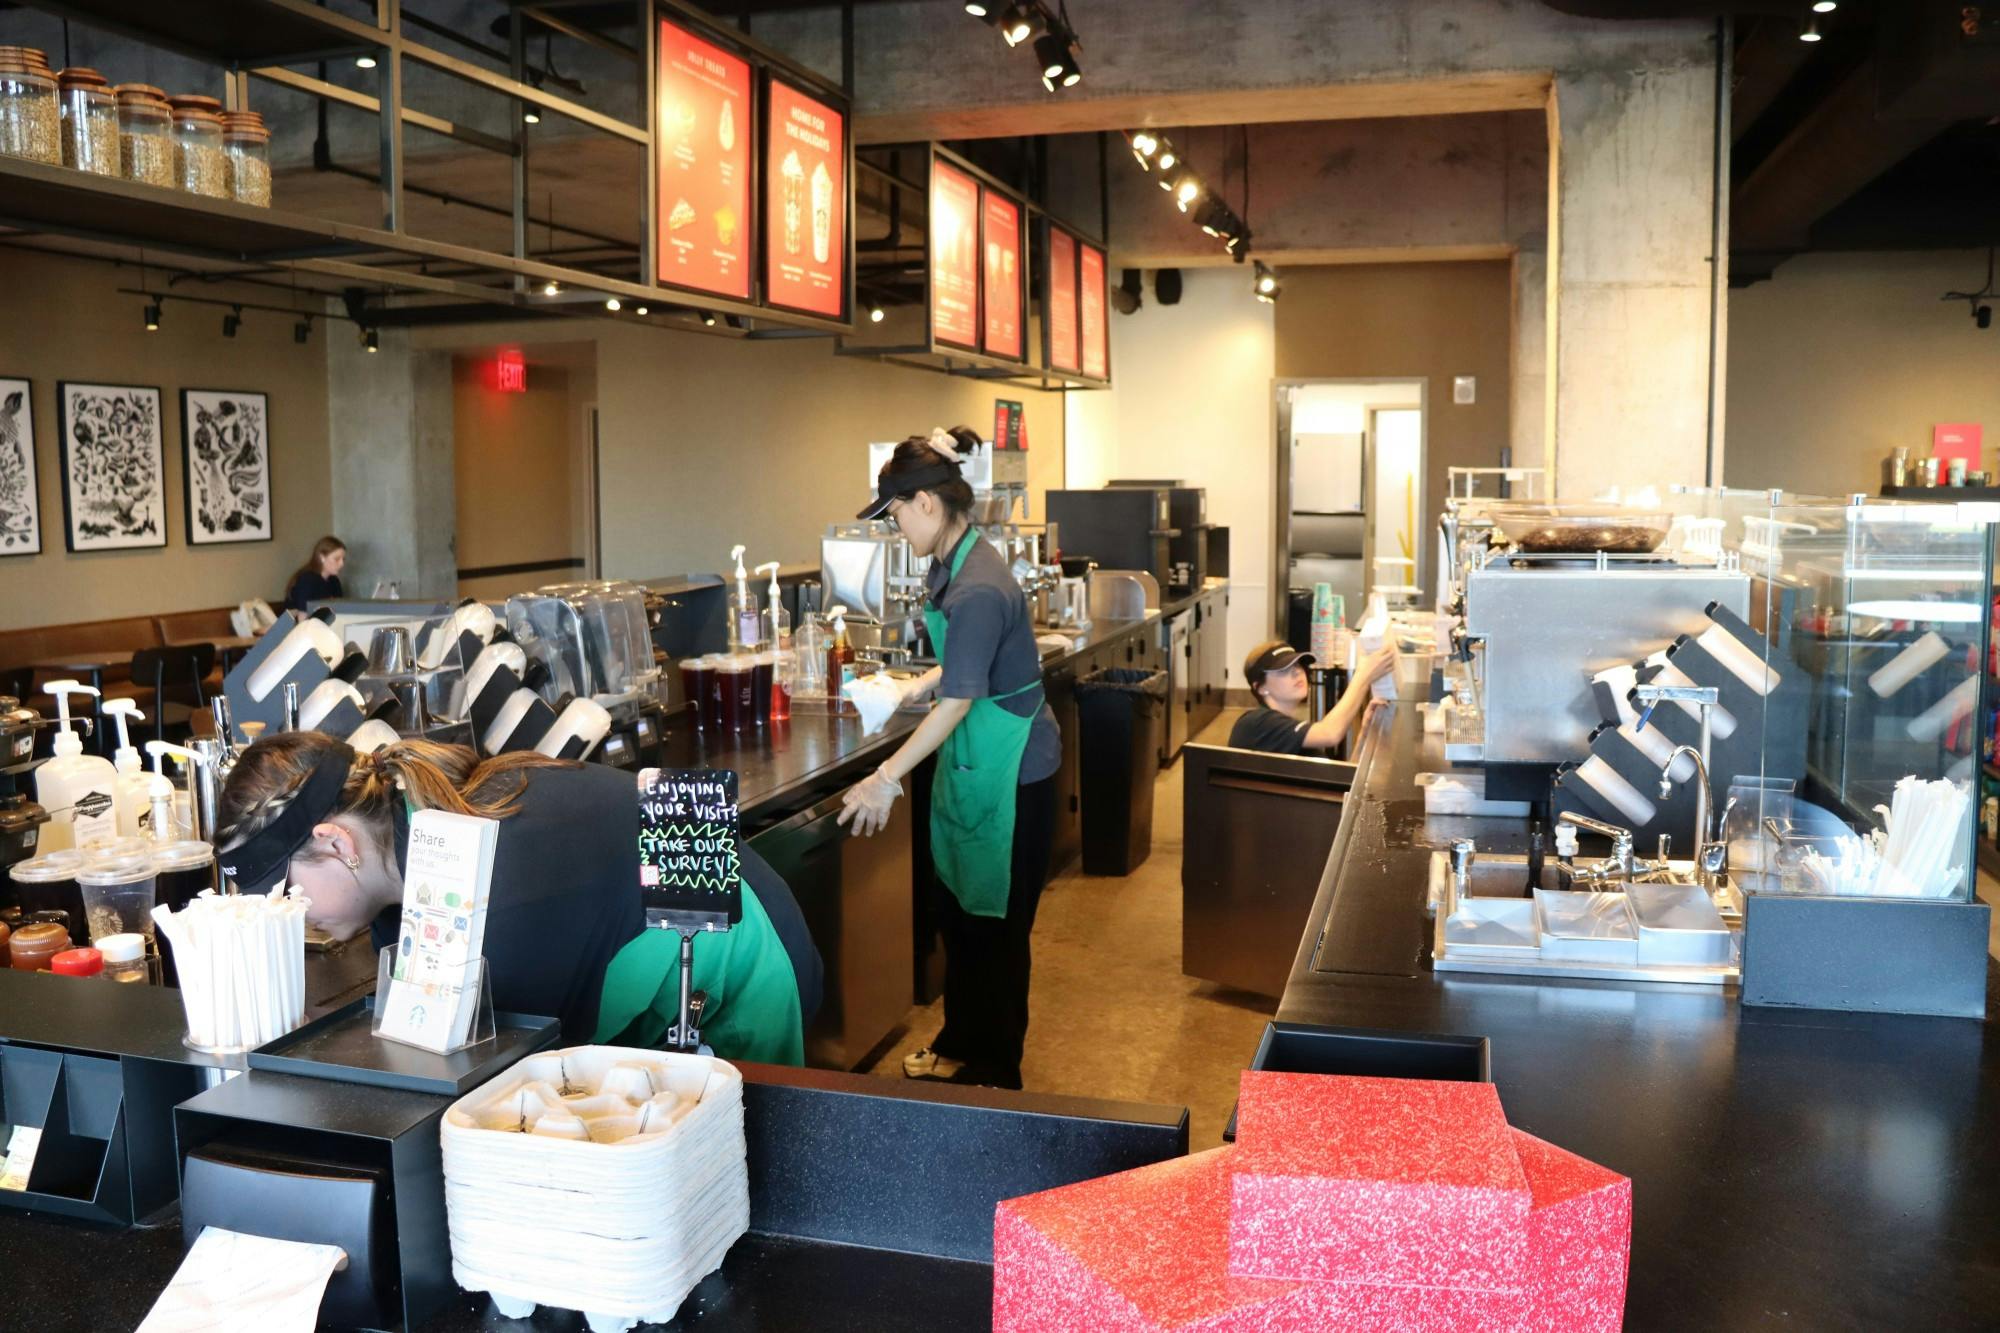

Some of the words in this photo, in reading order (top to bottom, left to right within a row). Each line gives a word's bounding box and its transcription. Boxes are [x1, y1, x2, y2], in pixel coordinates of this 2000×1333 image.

[791, 106, 812, 127] HOME
[812, 115, 825, 133] FOR
[785, 121, 799, 139] THE
[799, 128, 830, 152] HOLIDAYS
[503, 363, 524, 390] EXIT
[646, 781, 726, 806] ENJOYING
[643, 802, 687, 823] YOUR
[693, 803, 738, 821] VISIT?
[413, 828, 446, 848] Share
[644, 838, 690, 853] TAKE
[694, 838, 730, 853] OUR
[658, 854, 733, 879] SURVEY!
